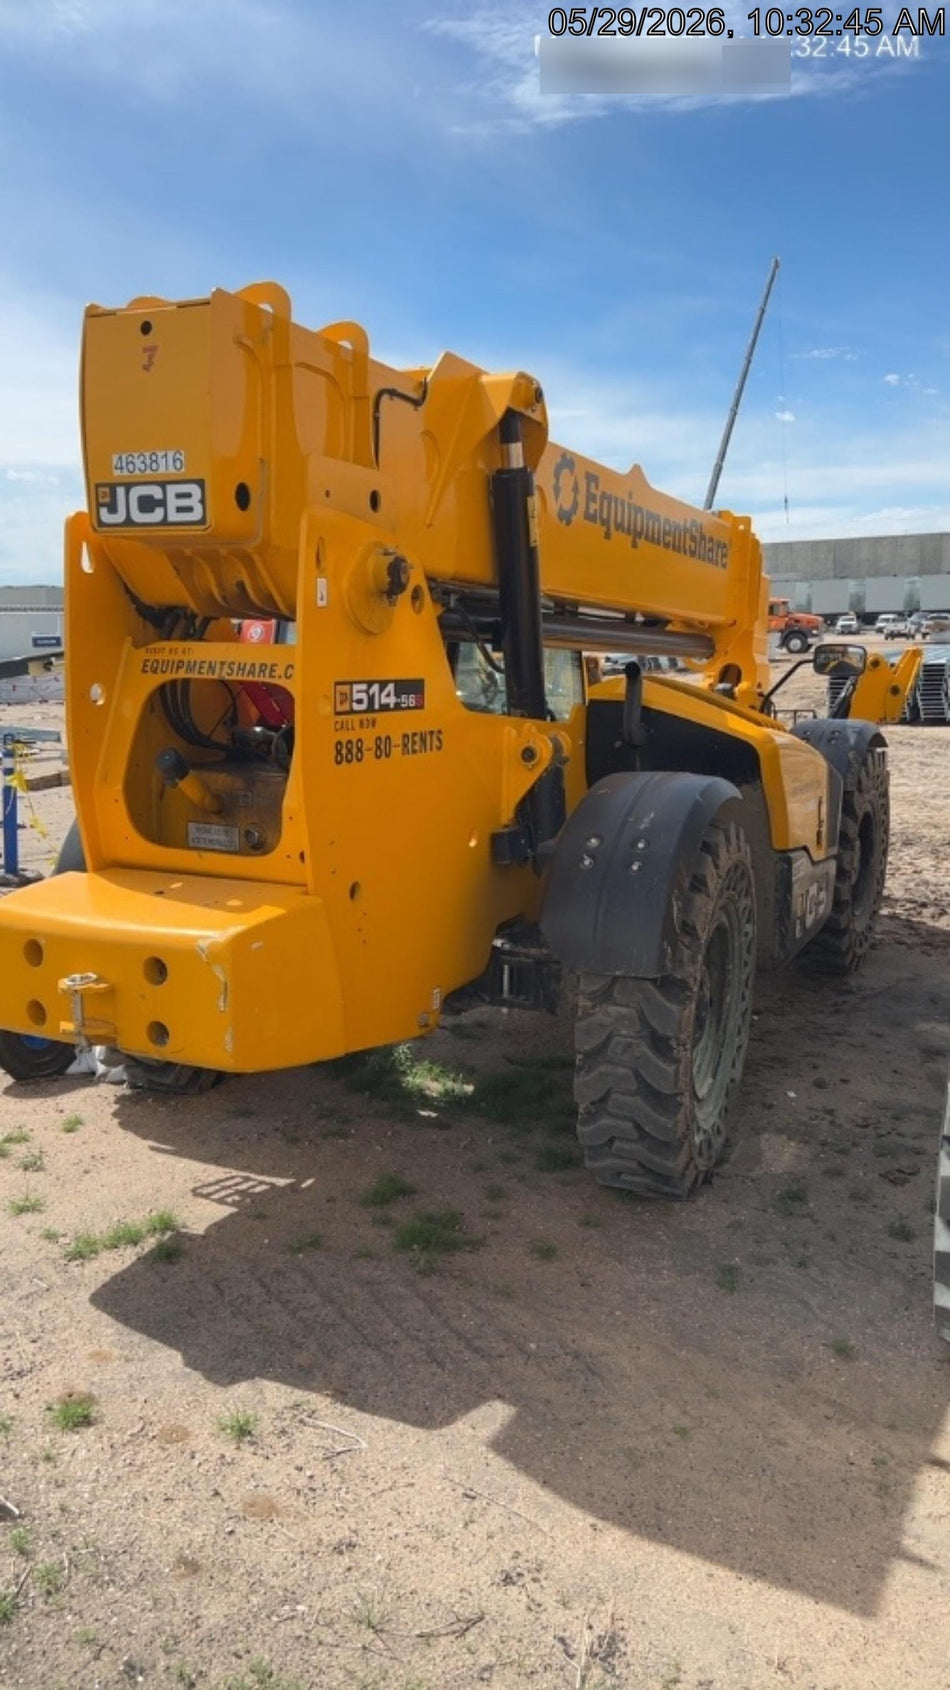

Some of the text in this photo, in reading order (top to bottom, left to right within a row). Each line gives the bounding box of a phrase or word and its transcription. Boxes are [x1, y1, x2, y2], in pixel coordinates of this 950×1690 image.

[114, 451, 183, 474] 463816
[99, 483, 203, 524] JCB
[584, 472, 727, 569] EquipmentShare
[141, 659, 294, 679] EQUIPMENTSHARE.C
[334, 718, 377, 732] CALL NOW
[335, 729, 443, 765] 888-80-RENTS
